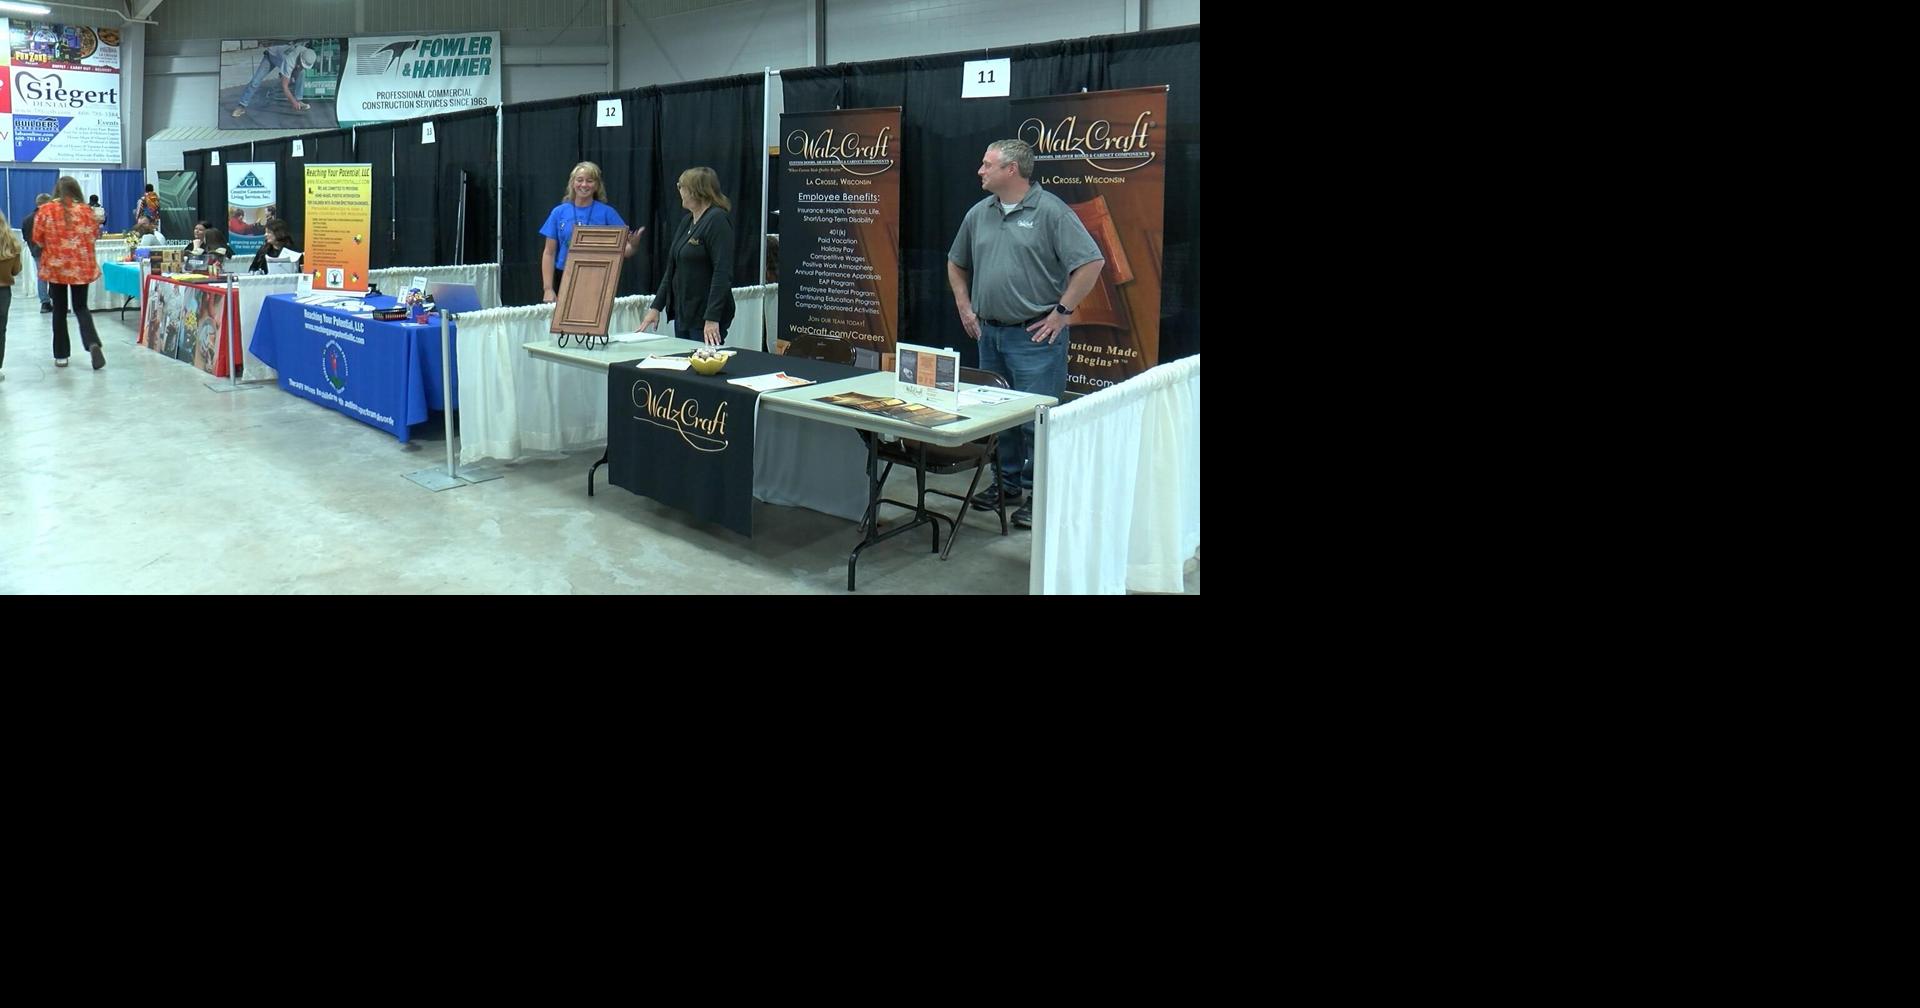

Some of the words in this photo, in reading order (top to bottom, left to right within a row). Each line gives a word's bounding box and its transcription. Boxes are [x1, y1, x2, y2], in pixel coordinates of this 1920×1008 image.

[419, 36, 493, 58] FOWLER
[402, 63, 411, 77] &
[412, 57, 492, 79] HAMMER
[978, 70, 996, 84] 11
[27, 81, 118, 108] Siegert
[376, 90, 426, 99] PROFESSIONAL
[428, 88, 472, 98] COMMERCIAL
[362, 100, 414, 109] CONSTRUCTION
[415, 99, 447, 108] SERVICES
[449, 98, 469, 107] SINCE
[471, 97, 488, 106] 1963
[605, 107, 616, 117] 12
[15, 120, 59, 128] BUILDERS
[1018, 111, 1154, 160] WalzCraft
[786, 126, 892, 163] WalzCraft
[306, 168, 327, 178] Reaching
[328, 168, 338, 177] Your
[361, 168, 370, 177] LLC
[798, 193, 840, 202] Employee
[842, 193, 880, 202] Benefits:
[849, 216, 874, 224] Disability
[829, 229, 846, 237] 401(k)
[810, 253, 844, 261] Competitive
[839, 263, 873, 271] Atmosphere
[815, 270, 851, 278] Performance
[851, 272, 882, 280] Appraisals
[800, 285, 827, 293] Employee
[828, 287, 849, 295] Referral
[850, 289, 875, 297] Program
[795, 294, 824, 302] Continuing
[825, 295, 854, 303] Education
[855, 298, 880, 306] Program
[795, 302, 853, 312] Company-Sponsored
[854, 307, 880, 315] Activities
[304, 308, 323, 324] Reaching
[322, 312, 333, 324] Your
[333, 315, 355, 332] Potential,
[354, 320, 365, 333] LLC
[789, 324, 885, 343] WalzCraft.com/Careers
[1106, 345, 1138, 358] Made
[631, 379, 729, 441] WalzCraft
